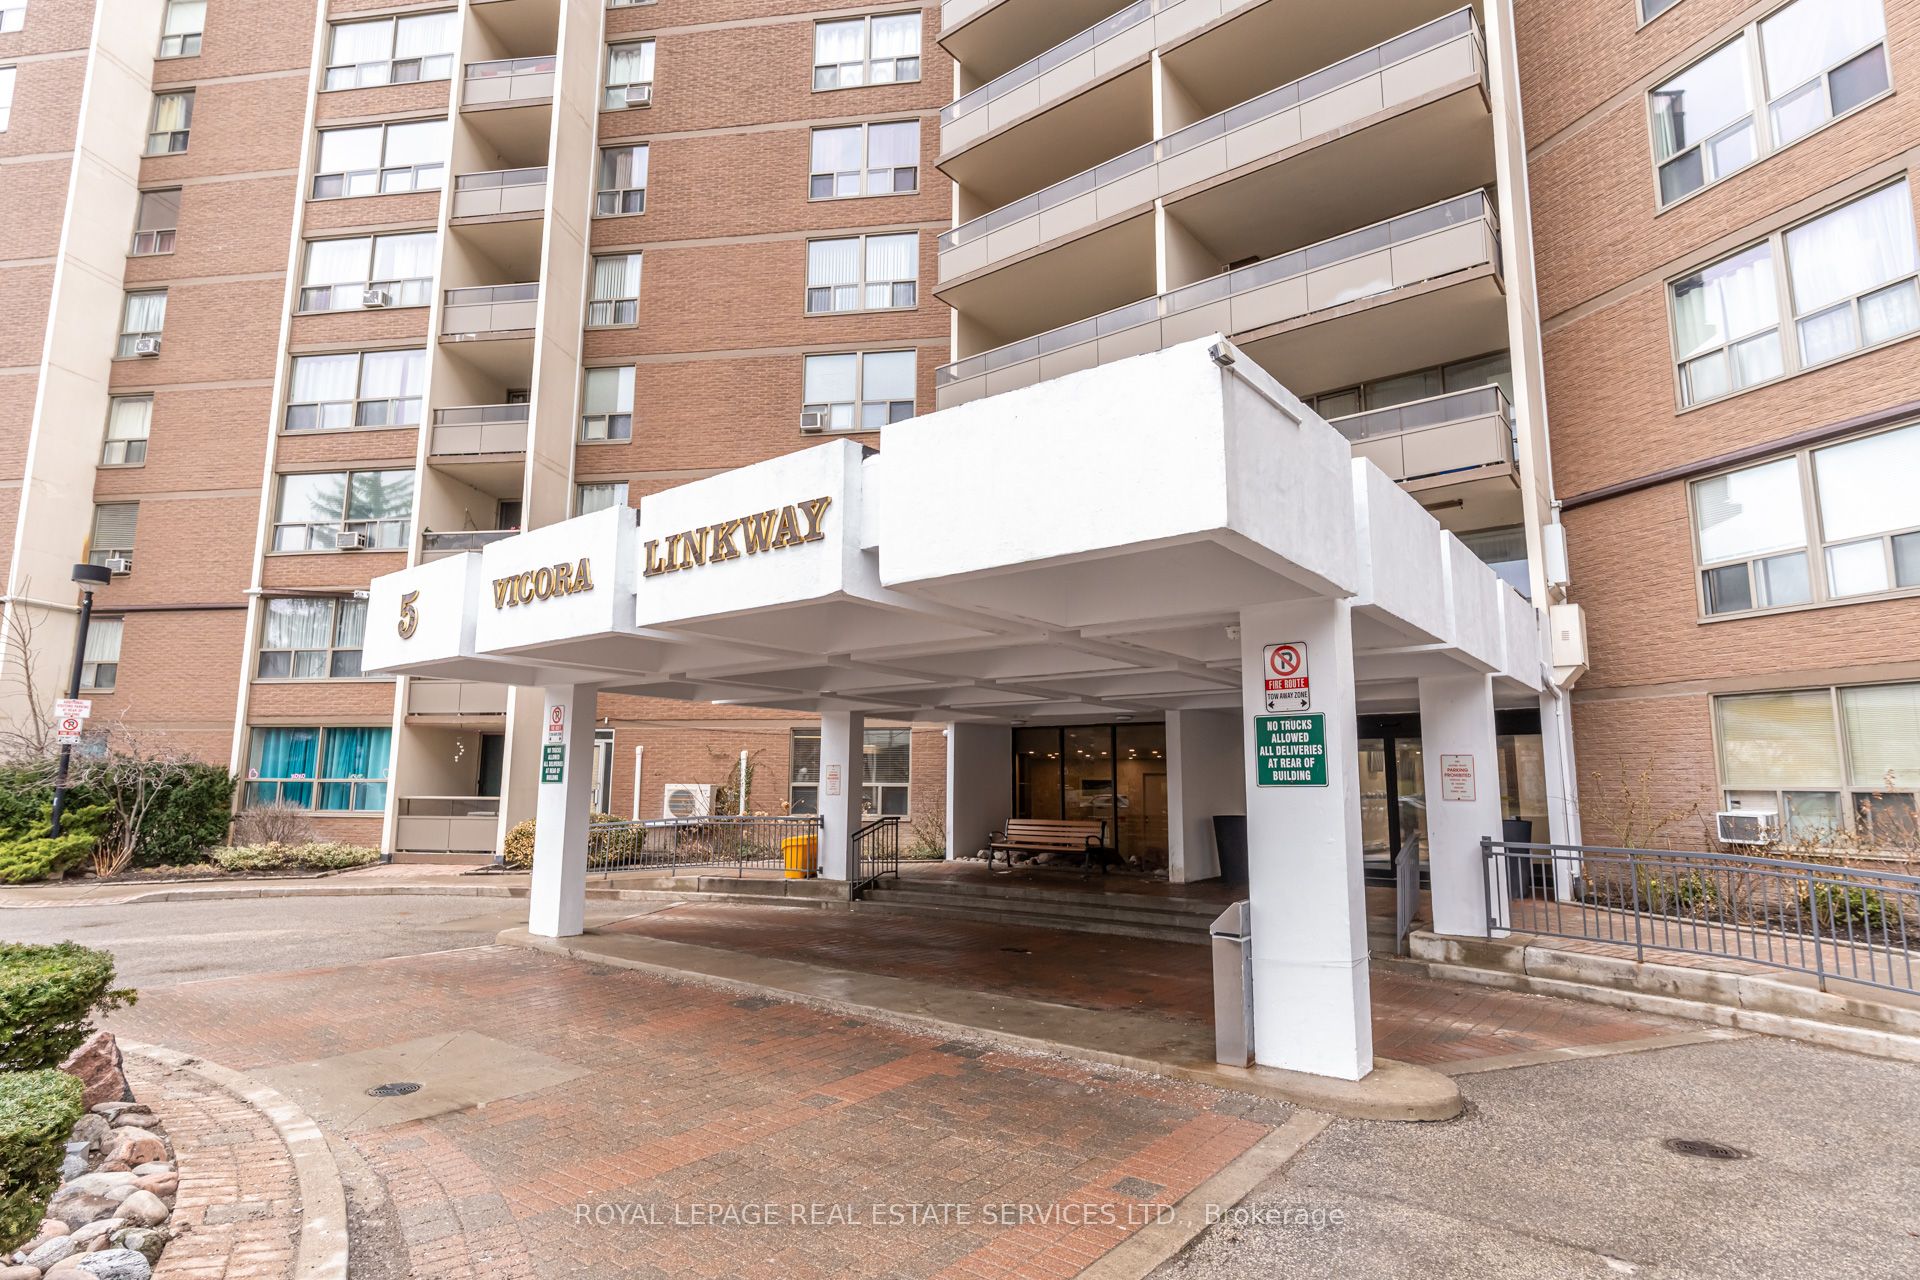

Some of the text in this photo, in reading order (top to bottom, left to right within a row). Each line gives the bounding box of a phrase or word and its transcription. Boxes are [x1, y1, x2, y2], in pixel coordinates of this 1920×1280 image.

[397, 495, 833, 639] 5 VICORA LINKWAY
[1268, 678, 1305, 690] FIRE ROUTE
[1279, 692, 1294, 700] AWAY
[1294, 691, 1308, 699] ZONE
[1267, 719, 1312, 731] NO TRUCKS
[1271, 732, 1309, 744] ALLOWED
[1260, 744, 1323, 756] ALL DELIVERIES
[1268, 757, 1315, 769] AT REAR OF
[1273, 770, 1311, 781] BUILDING
